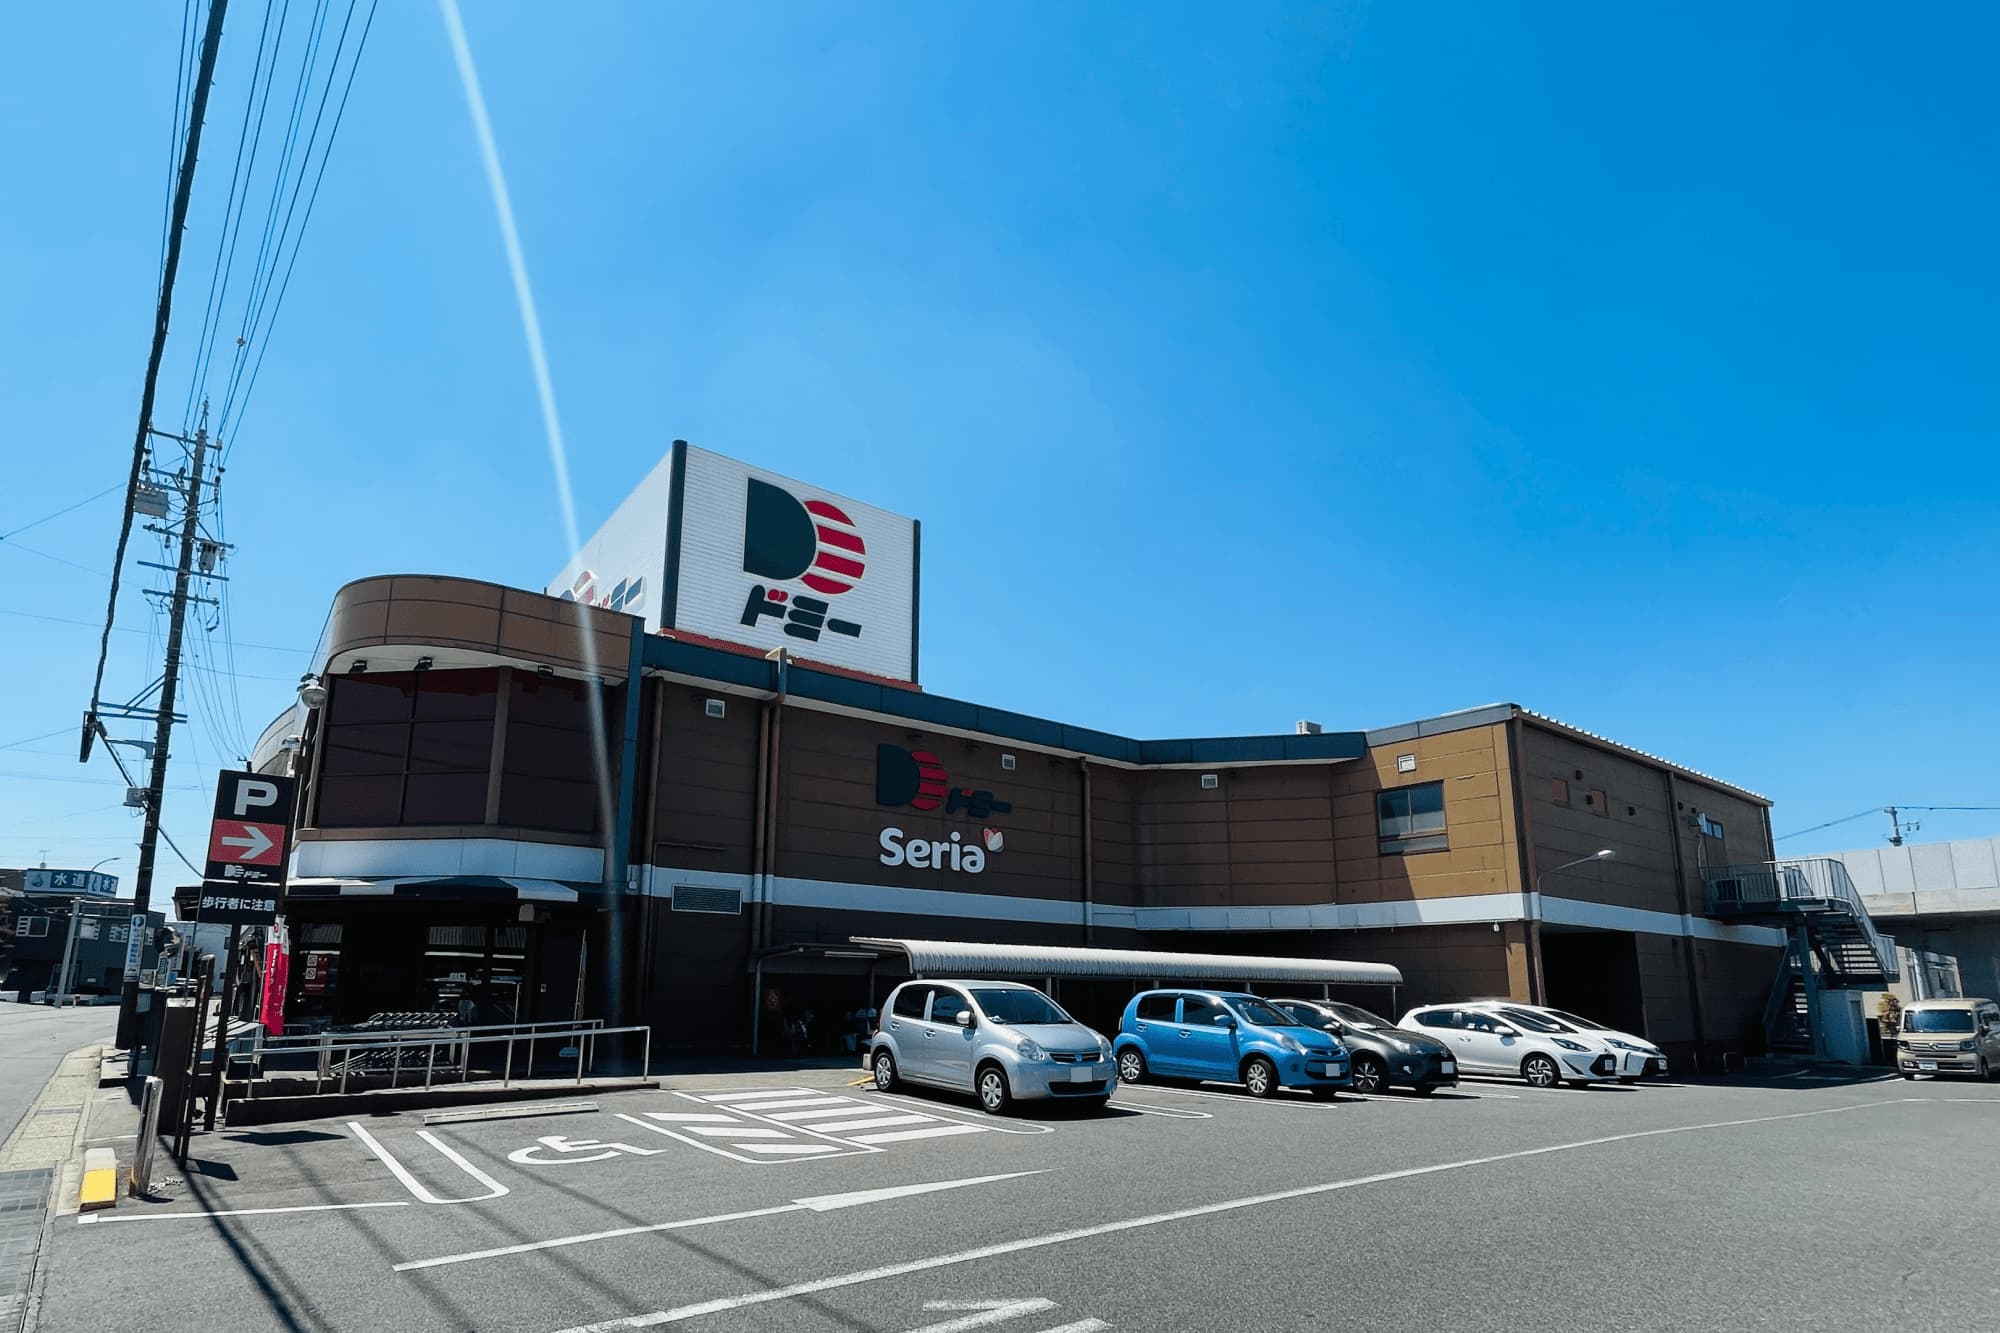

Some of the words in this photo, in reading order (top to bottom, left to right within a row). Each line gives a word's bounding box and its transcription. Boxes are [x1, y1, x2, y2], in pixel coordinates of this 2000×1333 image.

[740, 584, 863, 643] ドミー
[233, 779, 279, 816] P
[945, 787, 1013, 819] ドミー
[879, 827, 985, 874] Seria
[54, 872, 86, 887] 水道
[201, 896, 276, 912] 歩行者に注意
